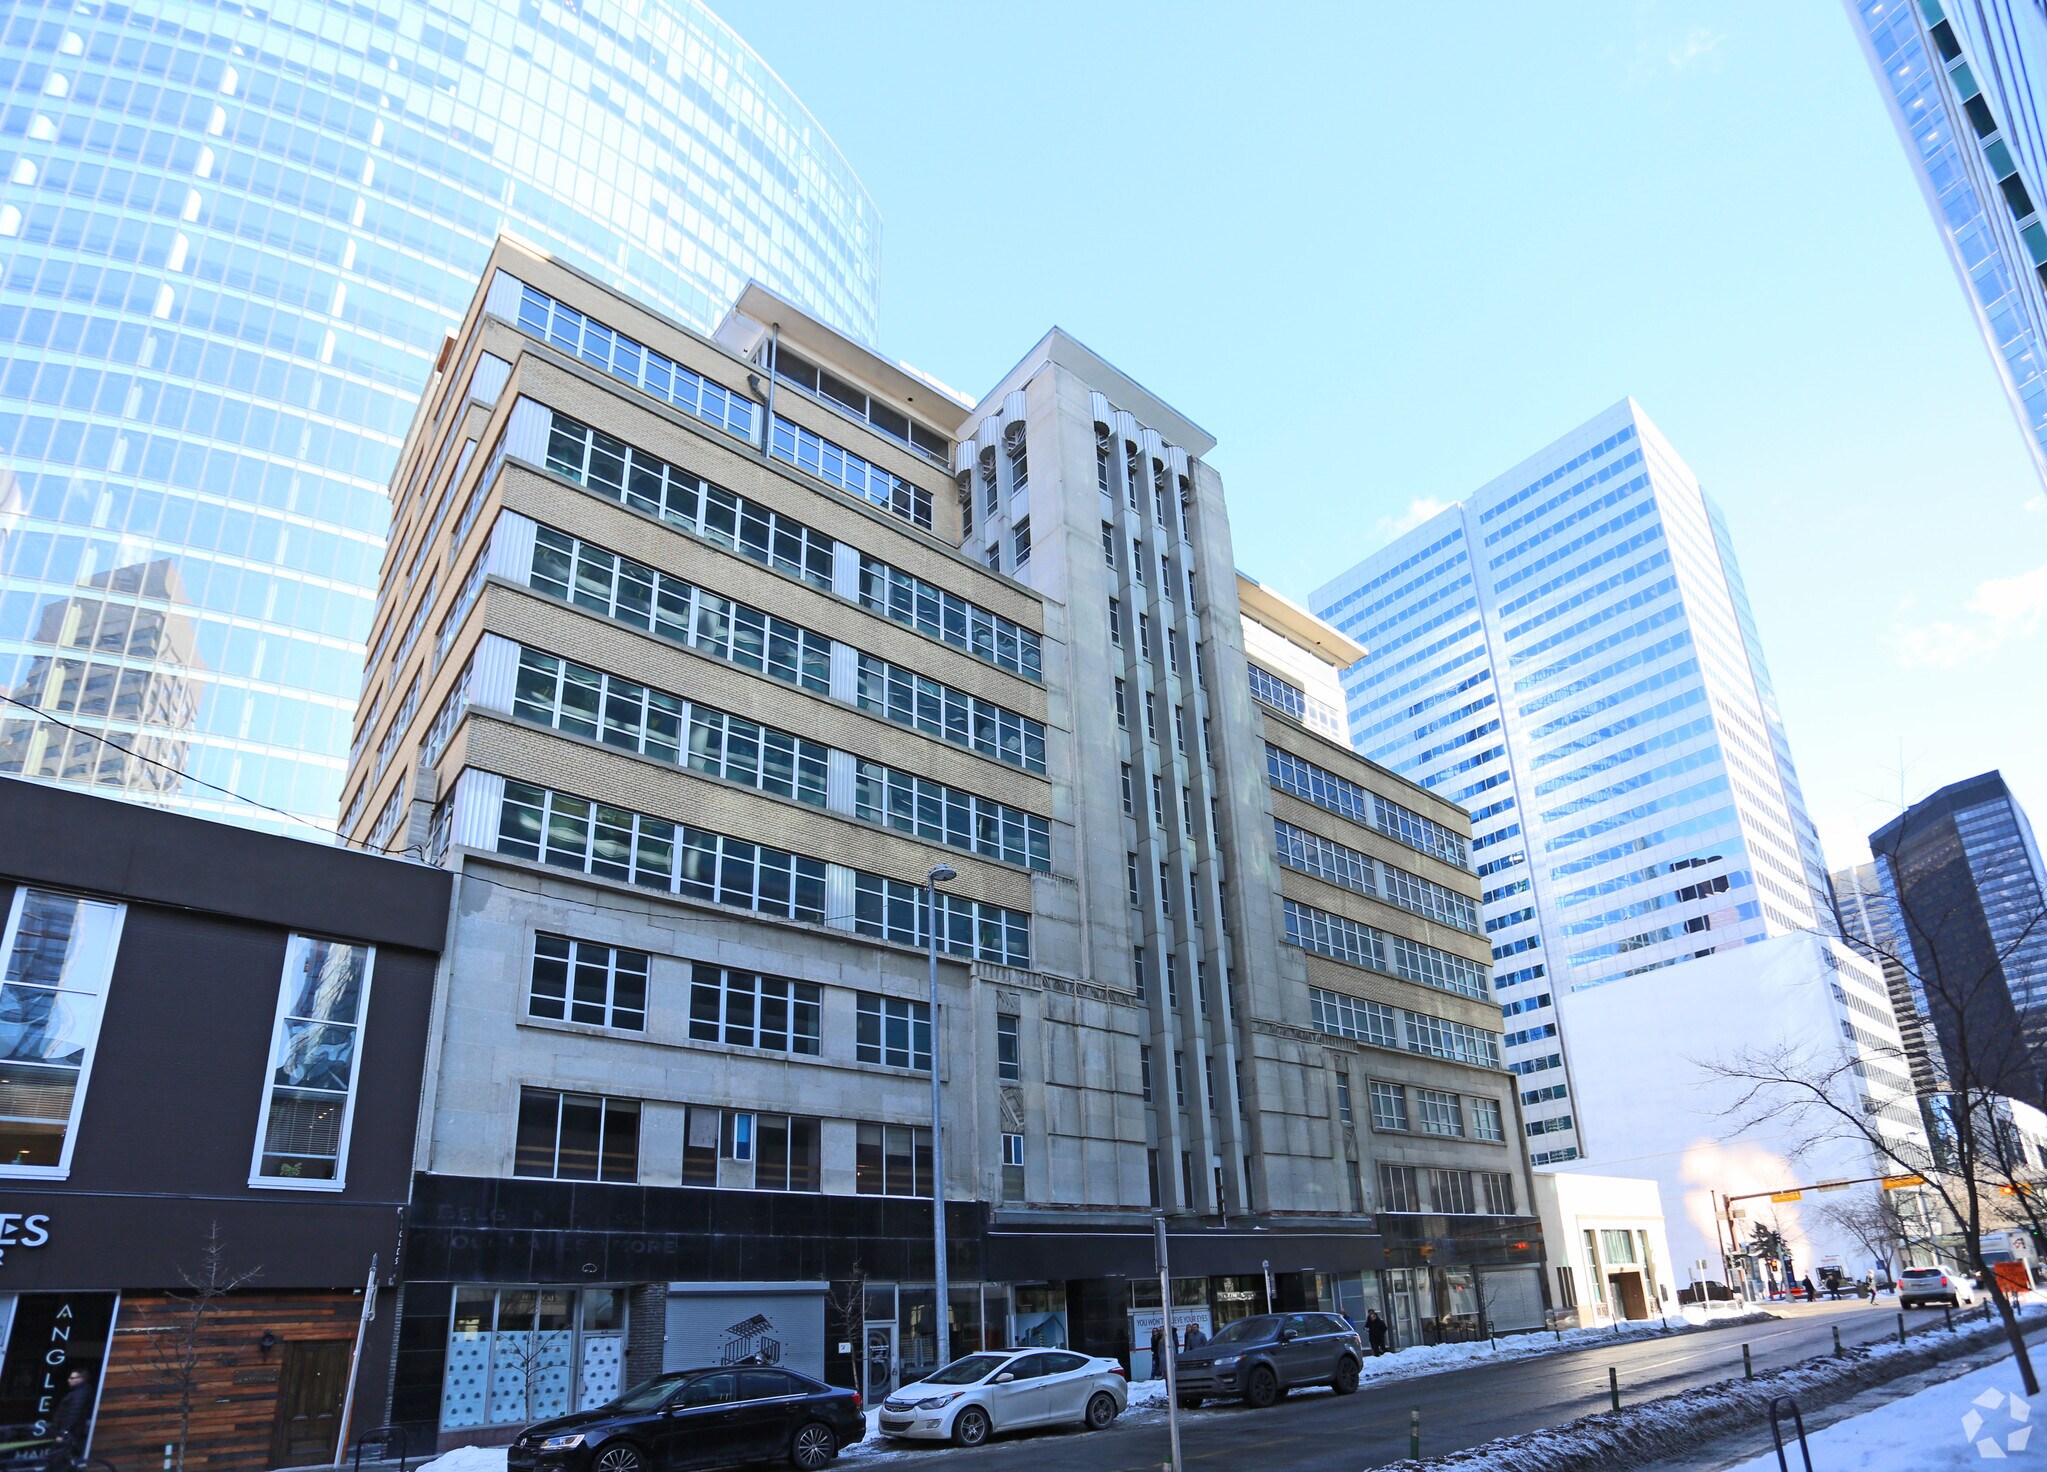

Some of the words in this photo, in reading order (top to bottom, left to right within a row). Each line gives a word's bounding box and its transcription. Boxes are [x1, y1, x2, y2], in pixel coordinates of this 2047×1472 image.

[1136, 1319, 1147, 1327] YOU
[1184, 1315, 1196, 1324] YOUR
[1197, 1314, 1208, 1323] EYES
[31, 1303, 74, 1437] ANGLES
